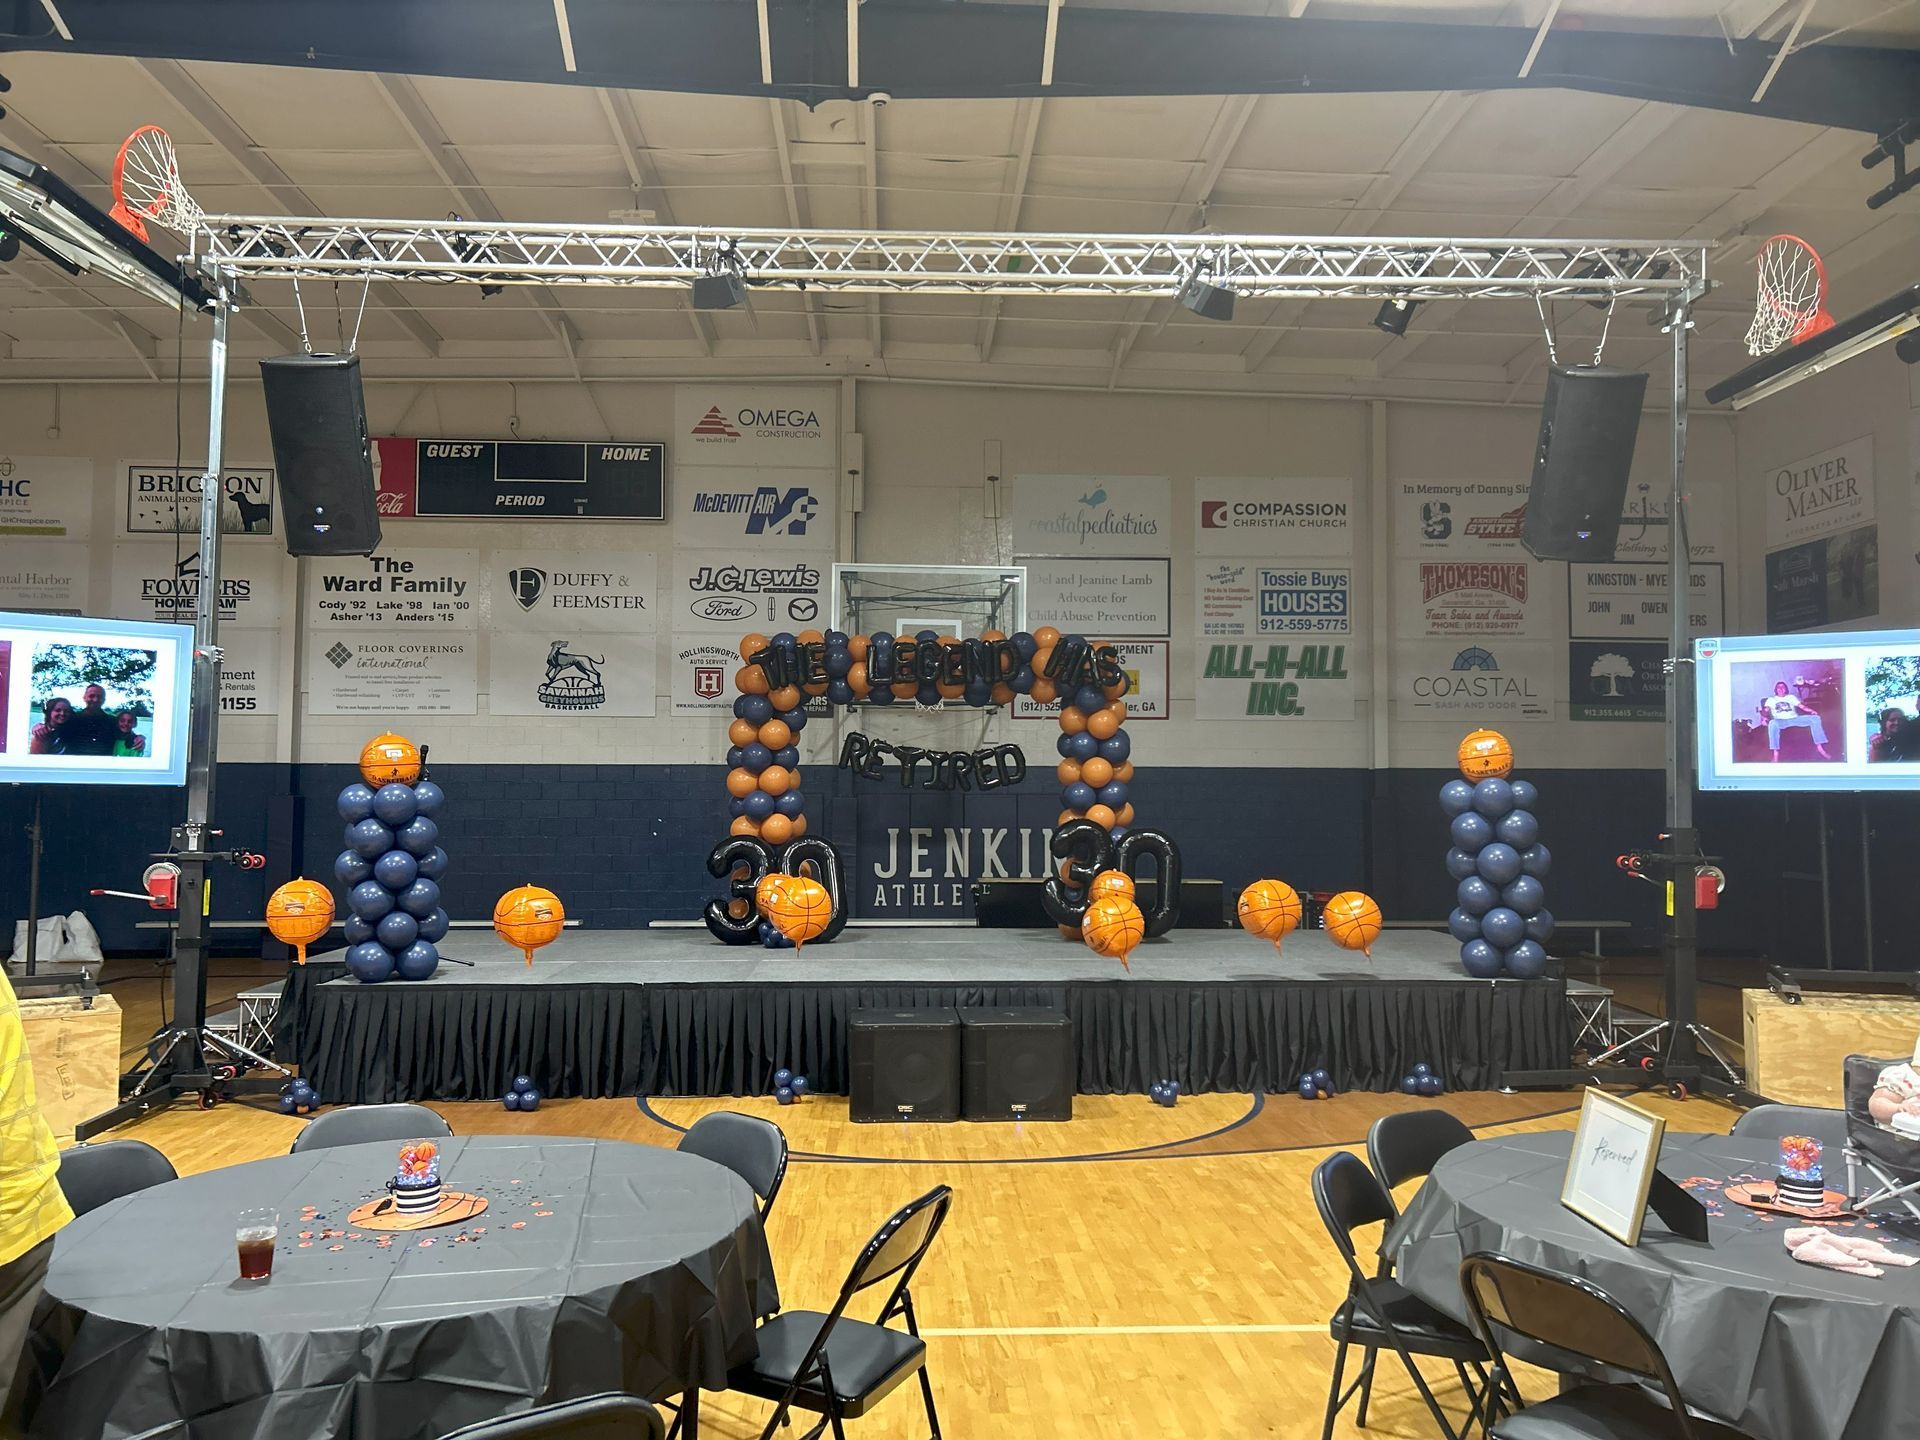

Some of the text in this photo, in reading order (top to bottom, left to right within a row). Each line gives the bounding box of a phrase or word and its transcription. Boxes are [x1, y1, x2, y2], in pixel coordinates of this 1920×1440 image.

[738, 408, 820, 428] OMEGA
[756, 429, 821, 439] CONSTRUCTION
[426, 444, 483, 459] GUEST
[601, 447, 652, 462] HOME
[138, 474, 264, 494] BRIGON
[1776, 457, 1849, 496] OLIVER
[0, 480, 31, 497] HC
[1403, 484, 1414, 494] In
[1416, 484, 1461, 497] Memory
[1464, 484, 1476, 494] of
[1477, 484, 1513, 497] Danny
[137, 495, 175, 504] ANIMAL
[495, 495, 547, 508] PERIOD
[693, 493, 777, 515] McDEVITT AIR
[1785, 477, 1859, 522] MANER
[1233, 502, 1347, 516] COMPASSION
[1233, 518, 1347, 529] CHRISTIAN CHURCH
[1466, 524, 1516, 534] STATE
[369, 557, 414, 573] The
[26, 573, 72, 585] Harbor
[323, 575, 467, 597] Ward Family
[553, 573, 630, 587] DUFFY &
[1055, 574, 1075, 585] and
[1078, 574, 1118, 588] Jeanine
[1121, 574, 1153, 585] Lamb
[1261, 571, 1308, 587] Tossie
[1311, 571, 1348, 589] Buys
[1420, 563, 1528, 604] THOMPSON'S
[1587, 573, 1706, 588] KINGSTON MYE IDS
[141, 578, 251, 596] FOWRS
[155, 598, 195, 609] HOME
[318, 600, 470, 611] Cody '92 Lake '98 Ian '00
[553, 594, 646, 610] FEEMSTER
[1058, 592, 1128, 604] Advocate for
[1264, 592, 1344, 613] HOUSES
[704, 599, 743, 617] Ford
[1450, 608, 1472, 621] Sales
[1475, 608, 1490, 621] and
[1587, 600, 1668, 615] JOHN OWEN
[330, 612, 455, 622] Asher '13 Anders '15
[1060, 610, 1094, 622] Abuse
[1096, 610, 1157, 622] Prevention
[1619, 613, 1635, 626] JIM
[1260, 618, 1349, 632] 912-559-5775
[357, 645, 464, 654] FLOOR COVERINGS
[678, 646, 741, 661] HOLLINGSWORTH
[356, 656, 429, 670] international
[866, 638, 1020, 687] LEGEND
[1202, 644, 1349, 680] ALL-N-ALL
[538, 684, 604, 697] SAVANNAH
[1413, 676, 1538, 698] COASTAL
[539, 694, 605, 705] GREYHOUNDS
[1245, 681, 1305, 717] INC.
[1434, 701, 1518, 710] SASH AND DOOR
[545, 702, 600, 712] BASKETBALL
[1020, 702, 1043, 712] (912)
[1141, 702, 1156, 712] GA
[840, 731, 1026, 792] RETIRED
[873, 827, 1066, 879] JENKIN
[1040, 820, 1182, 938] 30
[704, 834, 849, 945] 30
[1591, 1136, 1639, 1172] Reserved
